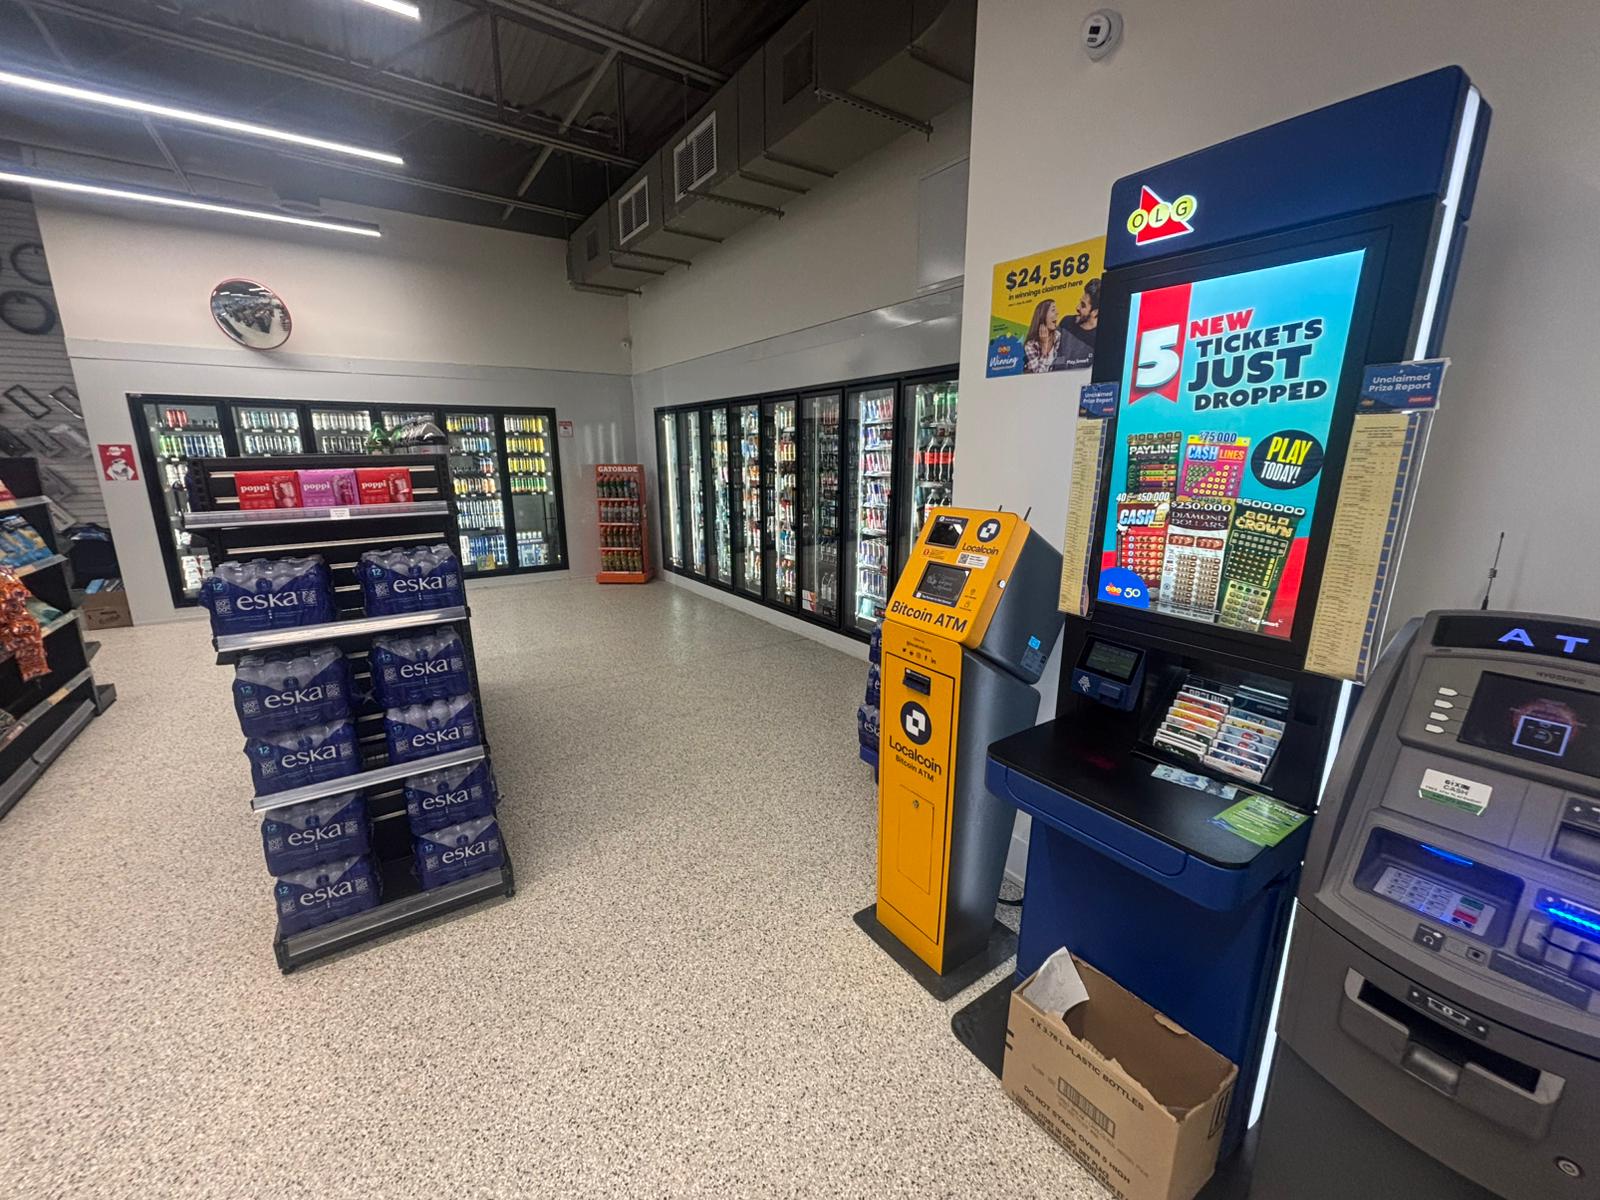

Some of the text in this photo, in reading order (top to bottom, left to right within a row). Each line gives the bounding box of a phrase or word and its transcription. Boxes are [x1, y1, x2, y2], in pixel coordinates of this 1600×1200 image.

[1130, 198, 1192, 232] OLG
[1006, 253, 1090, 291] $24,568
[1008, 279, 1084, 301] in winnings claimed here
[1189, 308, 1254, 339] NEW
[1196, 318, 1323, 358] TICKETS
[989, 356, 1019, 369] Winning
[1136, 324, 1180, 389] 5
[1188, 344, 1312, 392] JUST
[1372, 373, 1431, 384] Unclaimed
[1194, 380, 1327, 411] DROPPED
[1368, 382, 1431, 392] Prize Report
[1129, 444, 1178, 456] PAYLINE
[1219, 449, 1244, 461] LINES
[1266, 436, 1313, 465] PLAY
[1263, 461, 1300, 485] TODAY!
[240, 481, 271, 495] poppi
[303, 480, 331, 493] poppi
[361, 479, 387, 491] poppi
[1116, 492, 1127, 501] 40
[1119, 508, 1156, 526] CASH
[1171, 511, 1227, 522] DIAMOND
[1171, 518, 1225, 528] DOLLARS
[1235, 516, 1294, 538] CROWN
[961, 542, 999, 556] Localcoin
[371, 568, 383, 576] 12
[393, 575, 443, 593] eska
[1124, 587, 1141, 599] 50
[236, 591, 298, 611] eska
[891, 600, 968, 633] Bitcoin ATM
[399, 658, 449, 679] eska
[263, 686, 324, 709] eska
[412, 725, 460, 747] eska
[281, 744, 337, 768] eska
[889, 734, 942, 776] Localcoin
[895, 754, 935, 783] Bitcoin ATM
[422, 788, 469, 810] eska
[288, 823, 342, 846] eska
[441, 839, 486, 864] eska
[299, 881, 353, 906] eska
[1059, 1039, 1065, 1048] L
[1066, 1044, 1102, 1076] PLASTIC
[1102, 1073, 1145, 1112] BOTTLES
[1023, 1085, 1035, 1098] DO
[1035, 1095, 1051, 1112] NOT
[1052, 1110, 1077, 1137] STACK
[1078, 1133, 1101, 1158] OVER
[1108, 1161, 1131, 1185] HIGH
